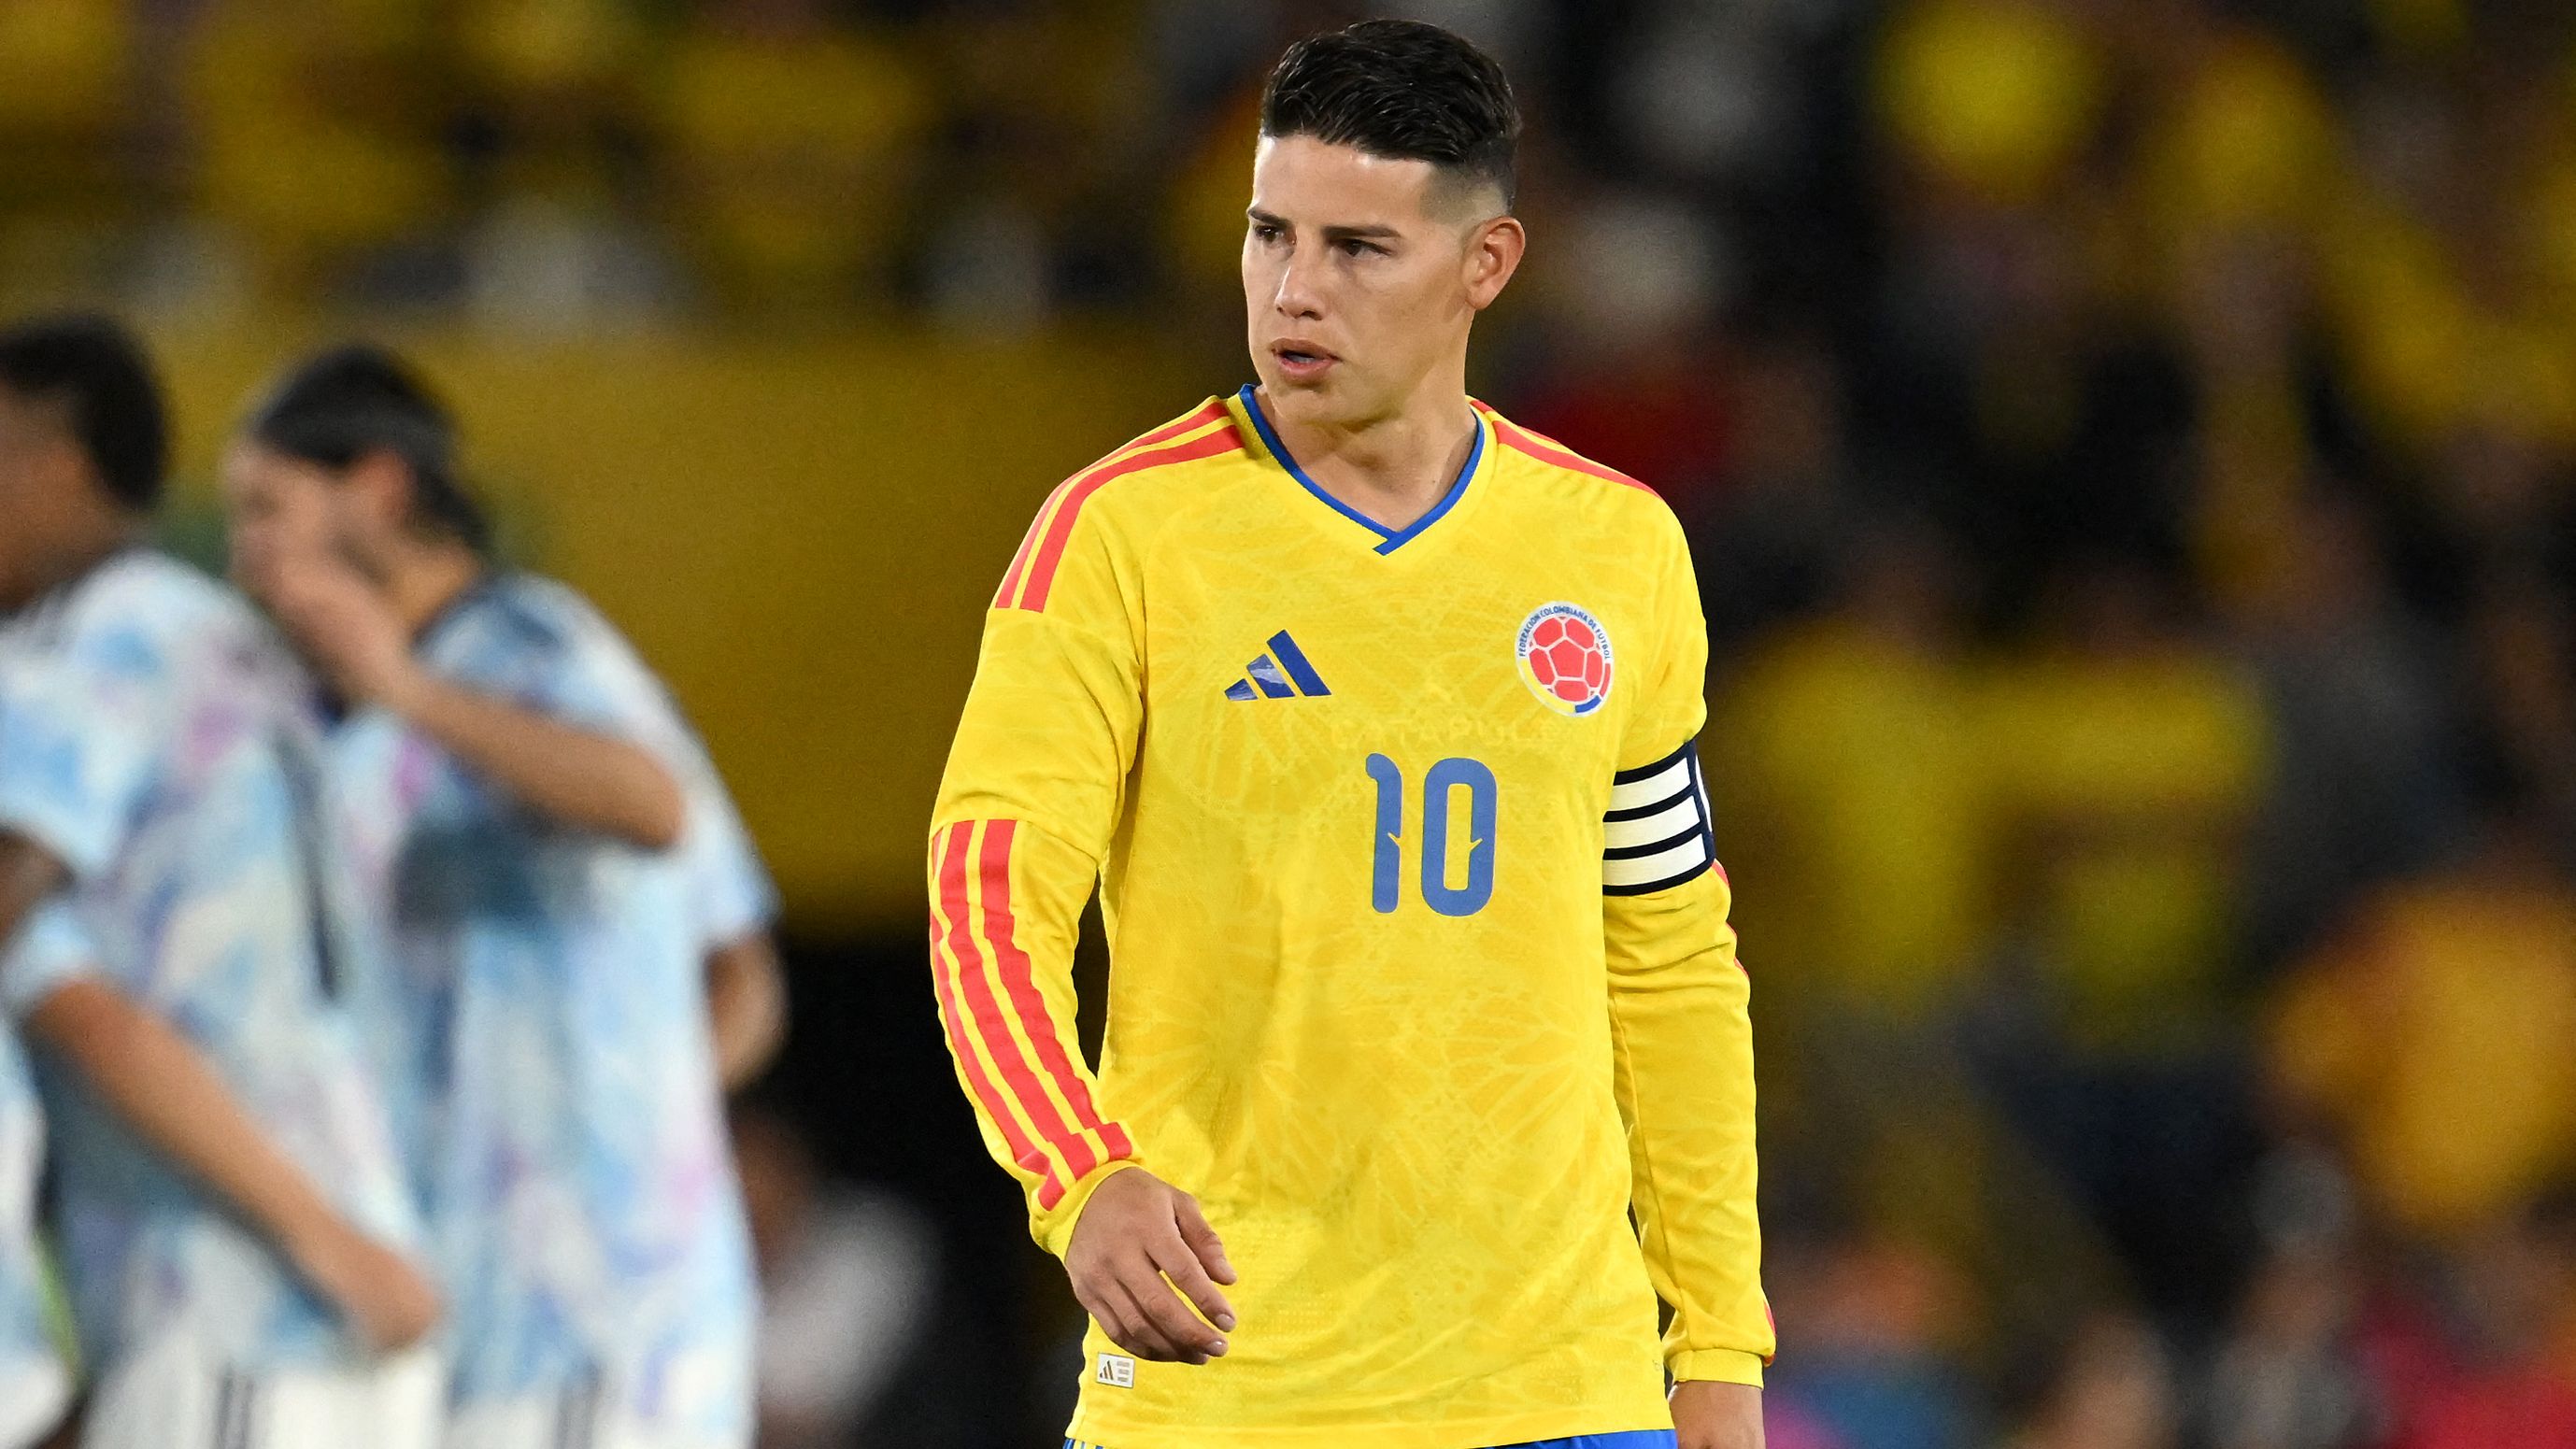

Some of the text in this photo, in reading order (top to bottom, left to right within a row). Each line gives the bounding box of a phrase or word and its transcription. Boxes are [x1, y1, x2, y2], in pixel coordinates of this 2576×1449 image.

[1540, 605, 1587, 622] COLOMBIANA
[1588, 618, 1597, 630] DE
[1595, 628, 1611, 660] FUTBOL
[1365, 753, 1497, 916] 10
